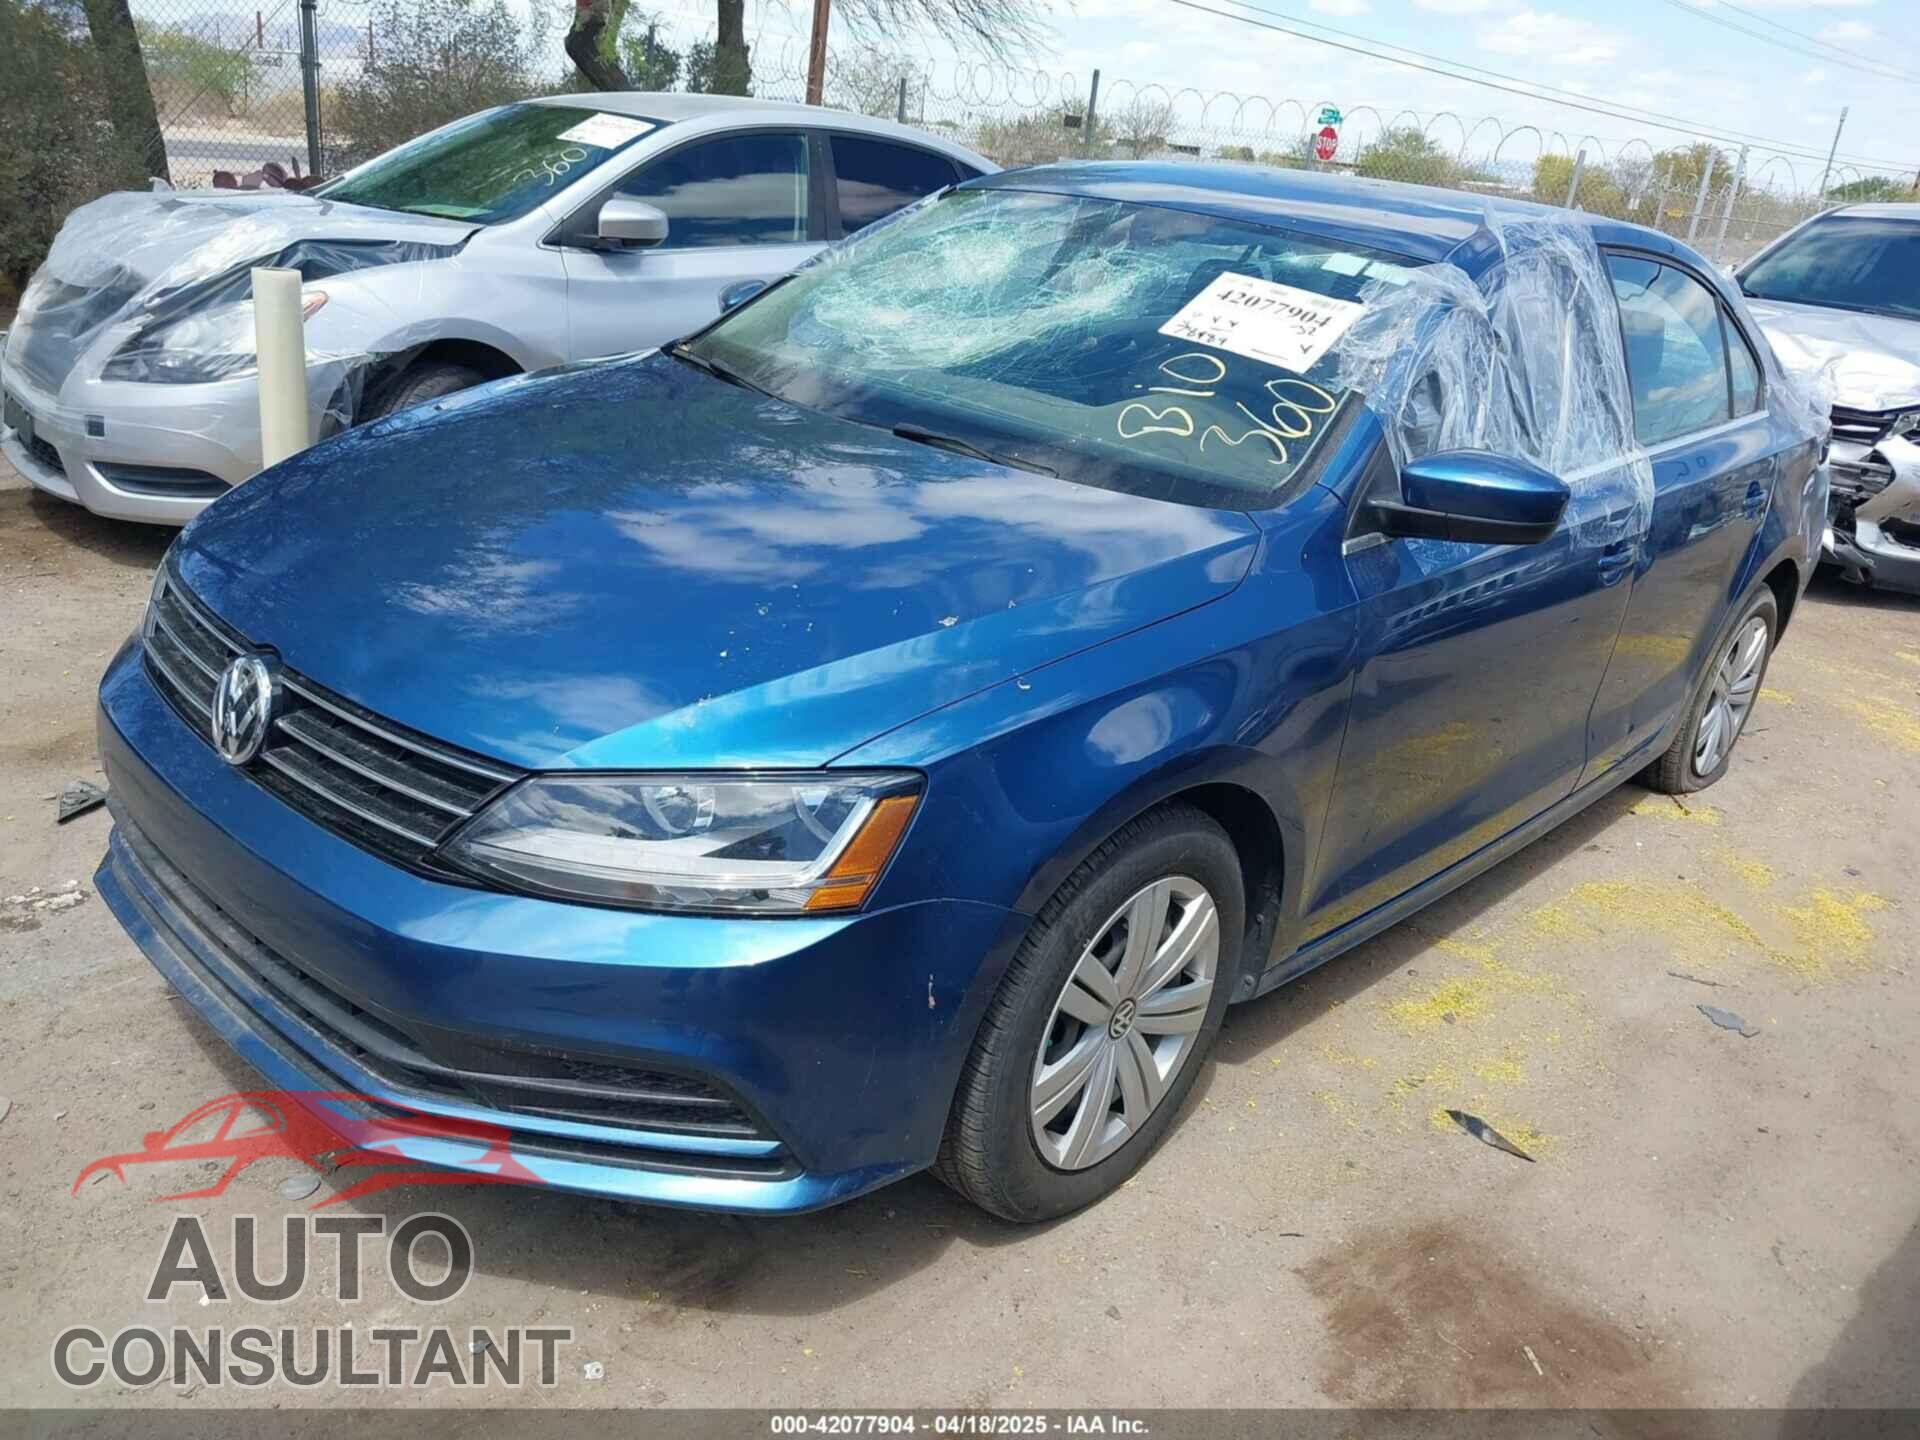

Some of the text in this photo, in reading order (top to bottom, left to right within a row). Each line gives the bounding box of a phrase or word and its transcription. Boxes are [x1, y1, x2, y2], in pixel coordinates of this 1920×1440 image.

[1317, 136, 1337, 149] STOP
[513, 148, 587, 185] 360
[1217, 289, 1332, 328] 42077904
[1200, 379, 1336, 464] 360
